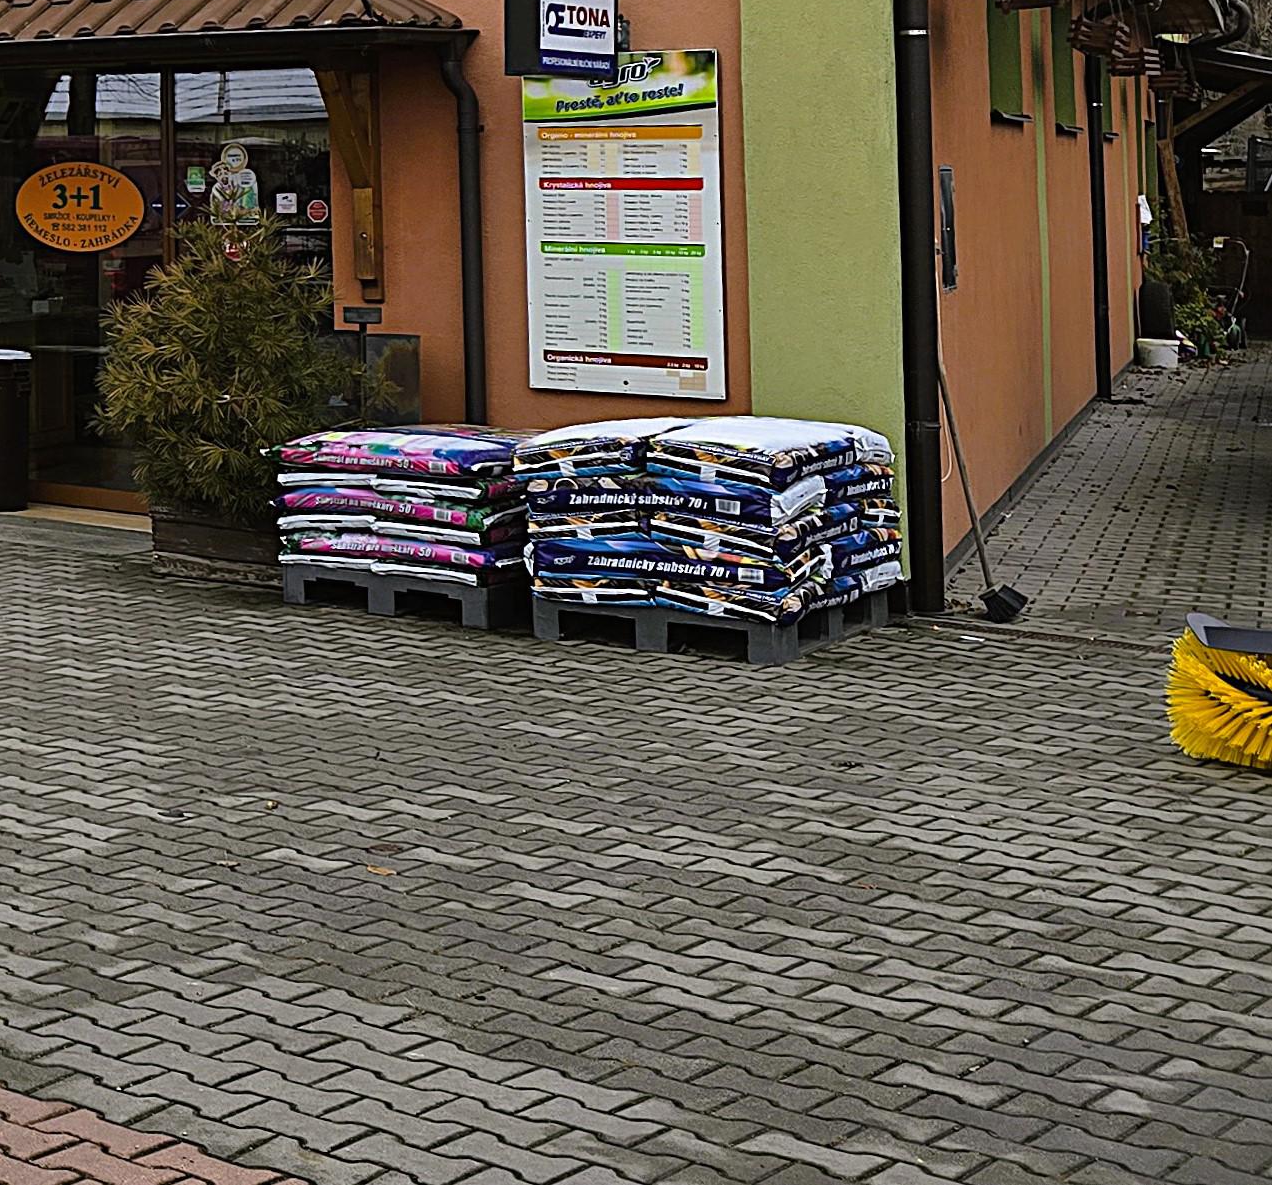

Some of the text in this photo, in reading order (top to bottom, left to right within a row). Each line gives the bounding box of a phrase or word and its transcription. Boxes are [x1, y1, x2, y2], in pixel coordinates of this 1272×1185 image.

[38, 164, 121, 189] ŽELEZÁŘSTVÍ
[51, 183, 104, 211] 3+1
[23, 212, 139, 249] ŘEMESLO ZAHRÁDKA
[398, 504, 411, 514] 50
[688, 497, 702, 509] 70
[417, 547, 431, 558] 50
[656, 560, 707, 577] substrát
[709, 566, 724, 578] 70
